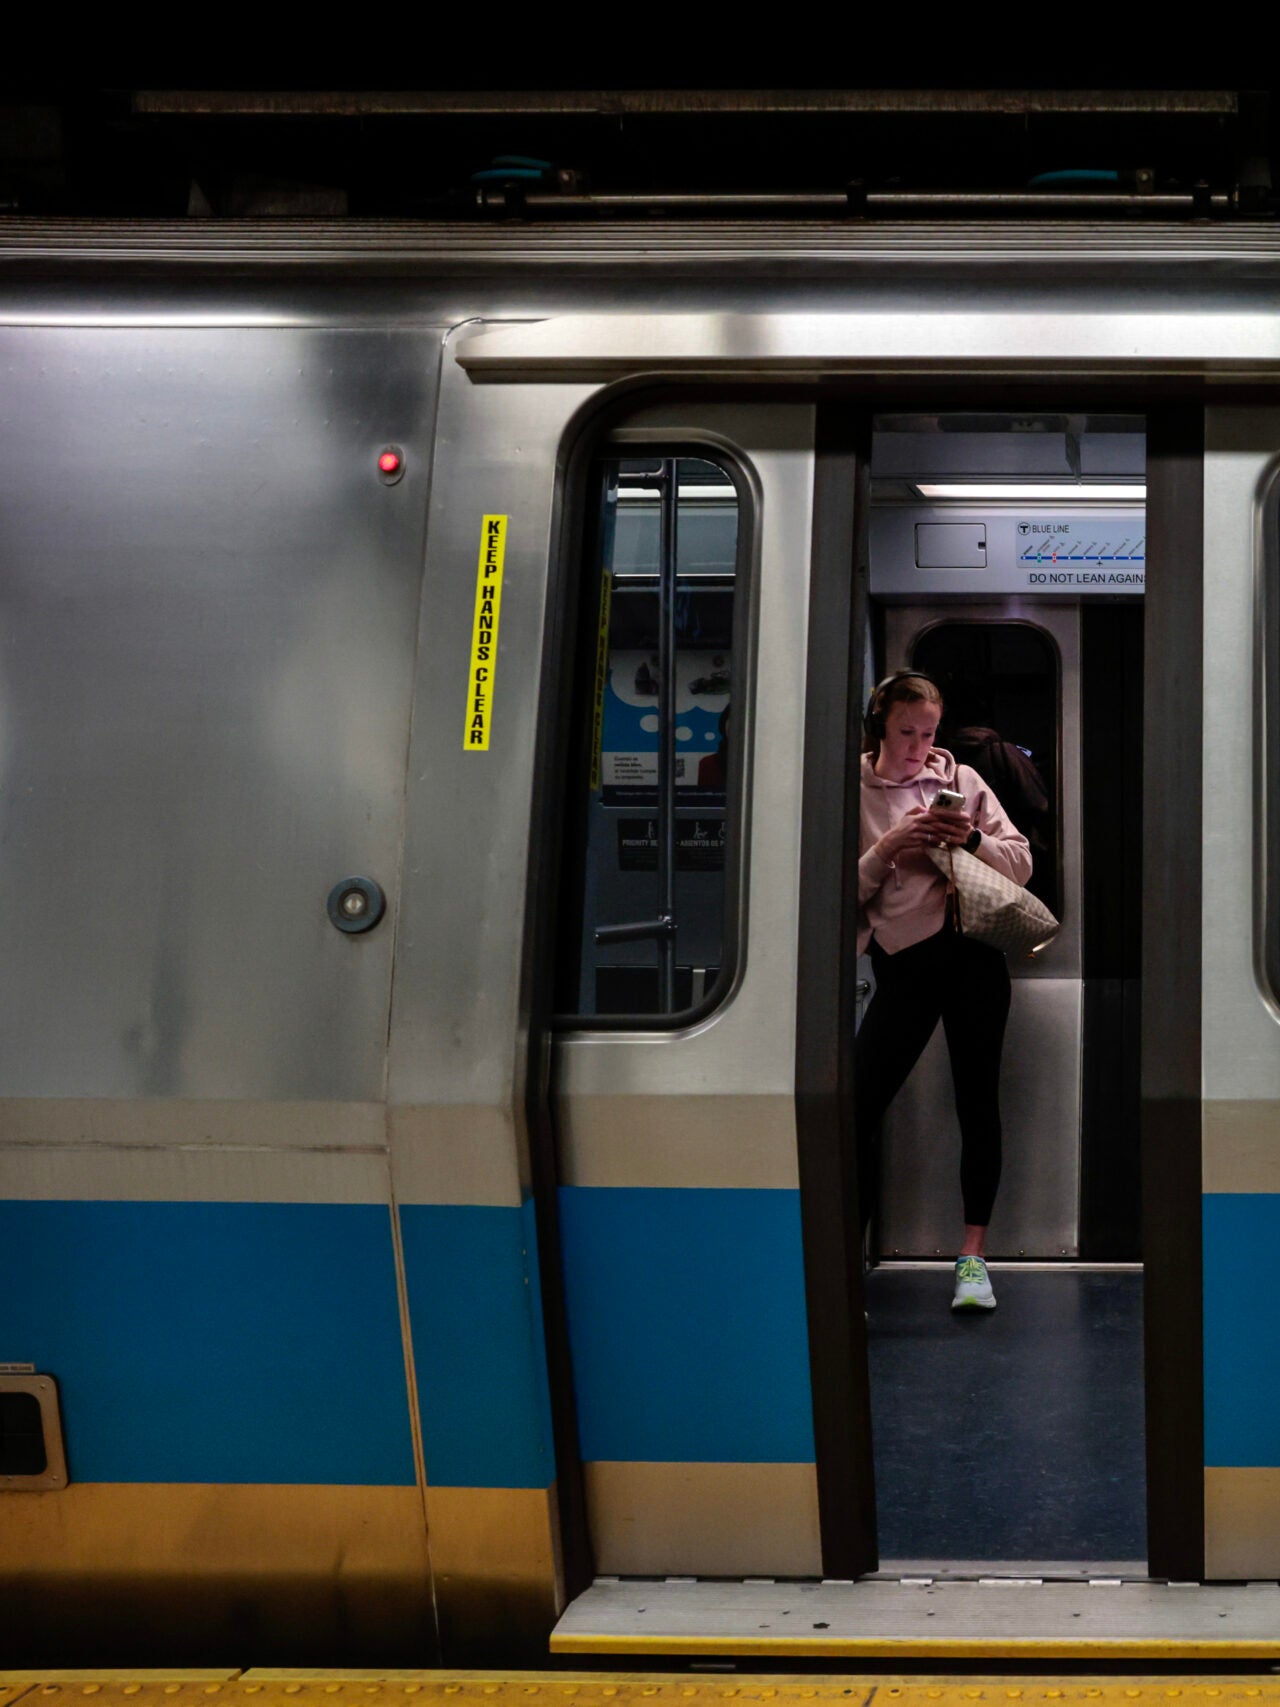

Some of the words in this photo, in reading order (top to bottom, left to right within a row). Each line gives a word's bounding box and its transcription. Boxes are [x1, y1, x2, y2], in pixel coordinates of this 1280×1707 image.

[484, 520, 501, 578] KEEP
[1032, 525, 1051, 534] BLUE
[1052, 525, 1070, 534] LINE
[1029, 573, 1047, 584] DO
[1049, 573, 1074, 584] NOT
[1076, 573, 1106, 584] LEAN
[477, 585, 495, 661] HANDS
[470, 667, 488, 745] CLEAR
